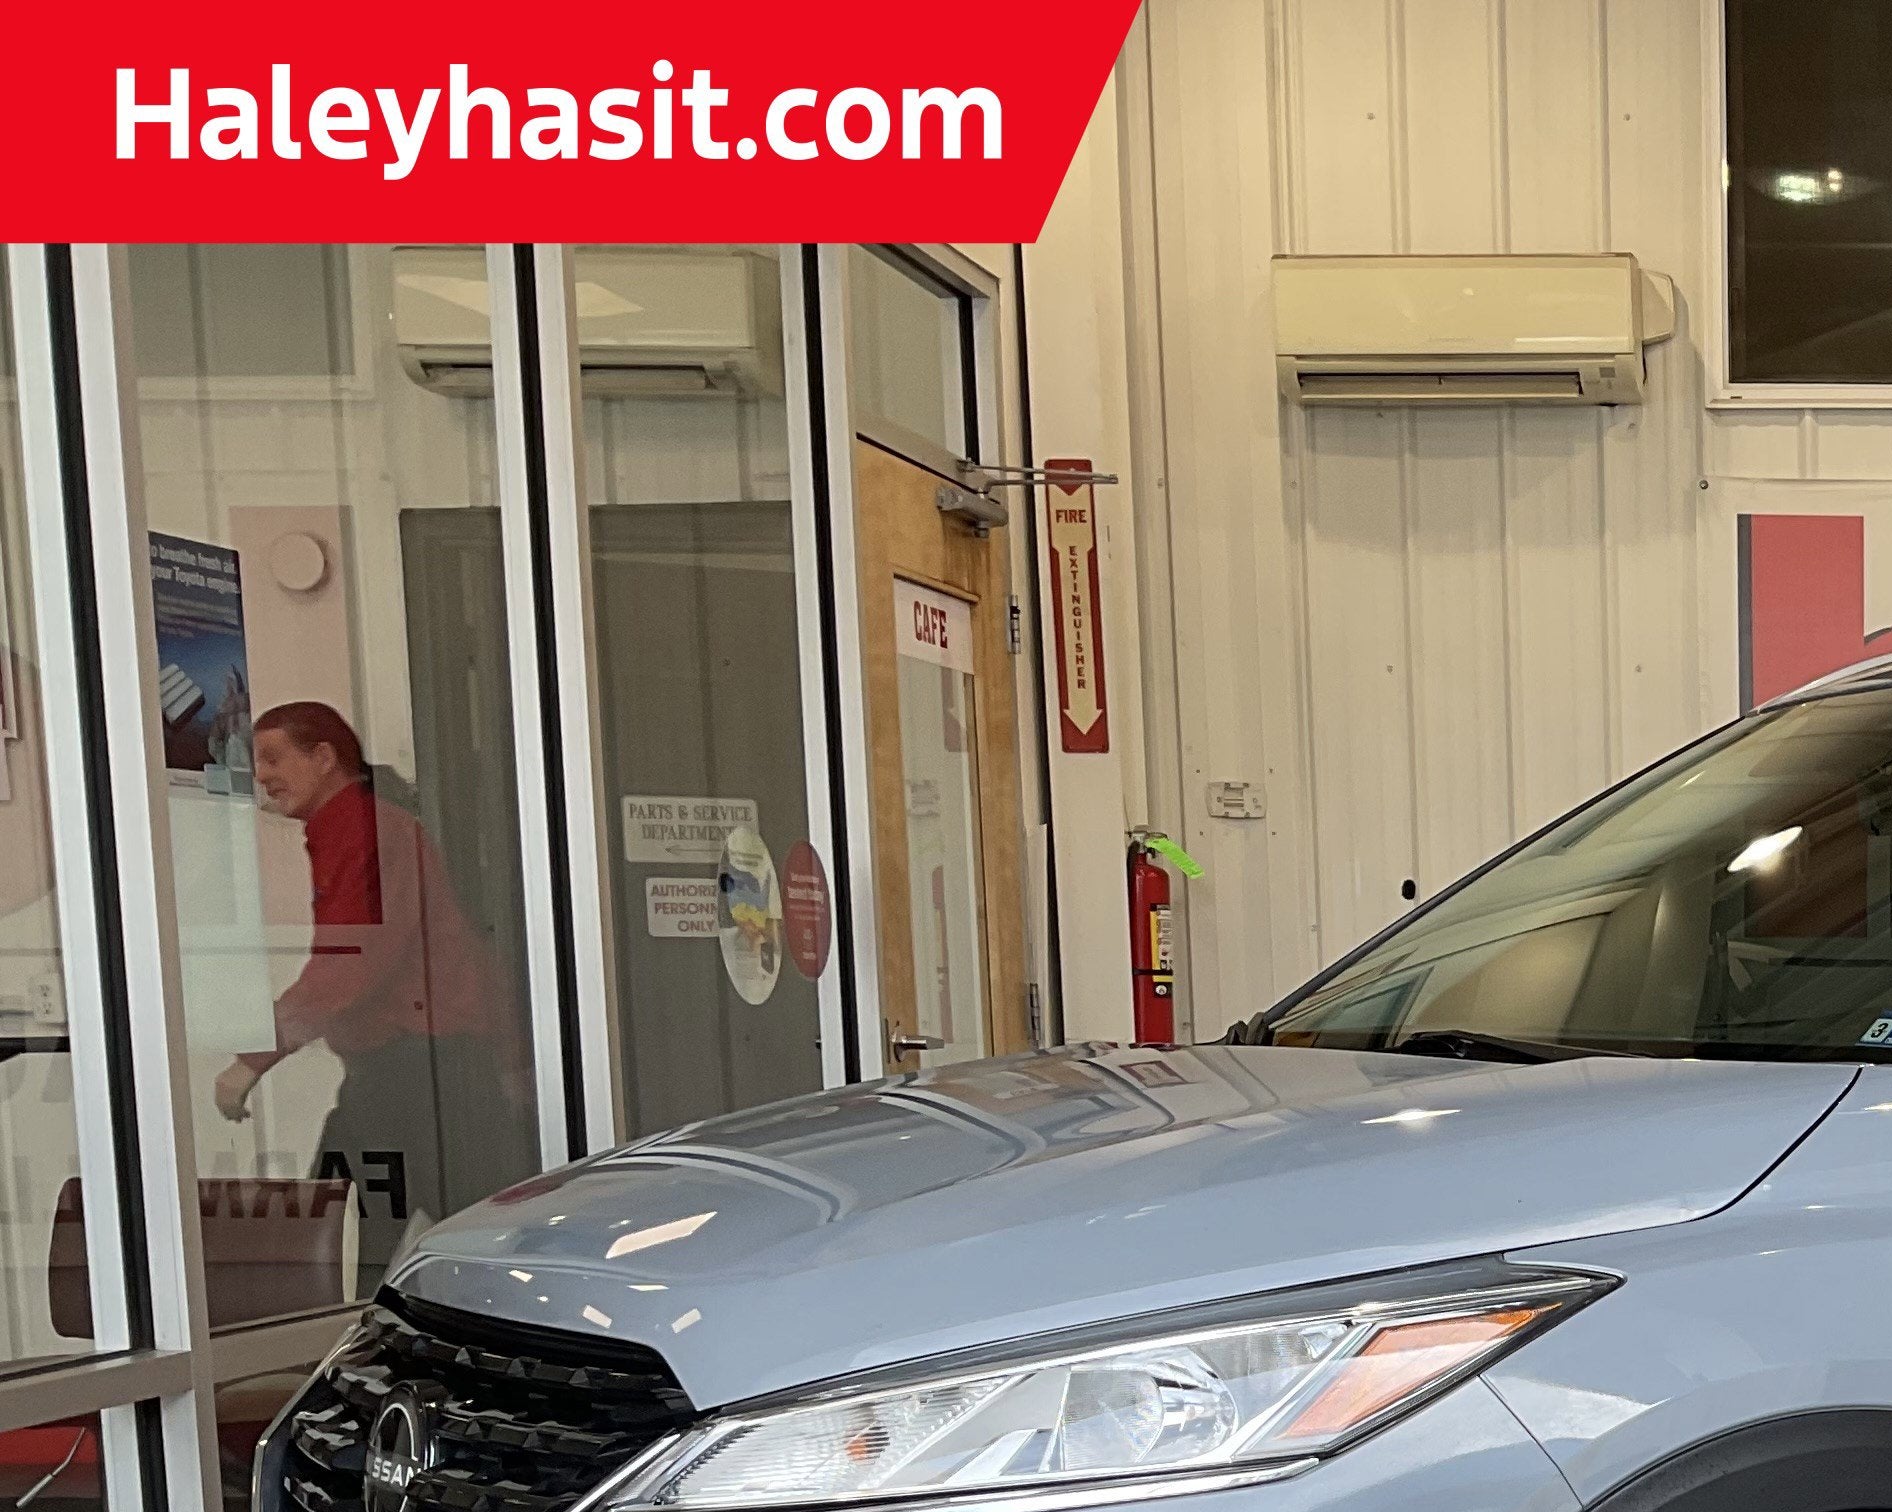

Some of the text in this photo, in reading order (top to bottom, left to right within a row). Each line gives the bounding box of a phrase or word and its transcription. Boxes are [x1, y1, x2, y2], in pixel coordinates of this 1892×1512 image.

[1056, 510, 1087, 523] FIRE
[914, 600, 948, 649] CAFE
[1069, 546, 1086, 689] EXTINGUISHER
[629, 803, 752, 822] PARTS & SERVICE
[651, 884, 717, 897] AUTHORIZ
[654, 902, 718, 914] PERSONN
[677, 920, 714, 932] ONLY
[1871, 1023, 1889, 1038] 3
[371, 1456, 422, 1487] SSAN
